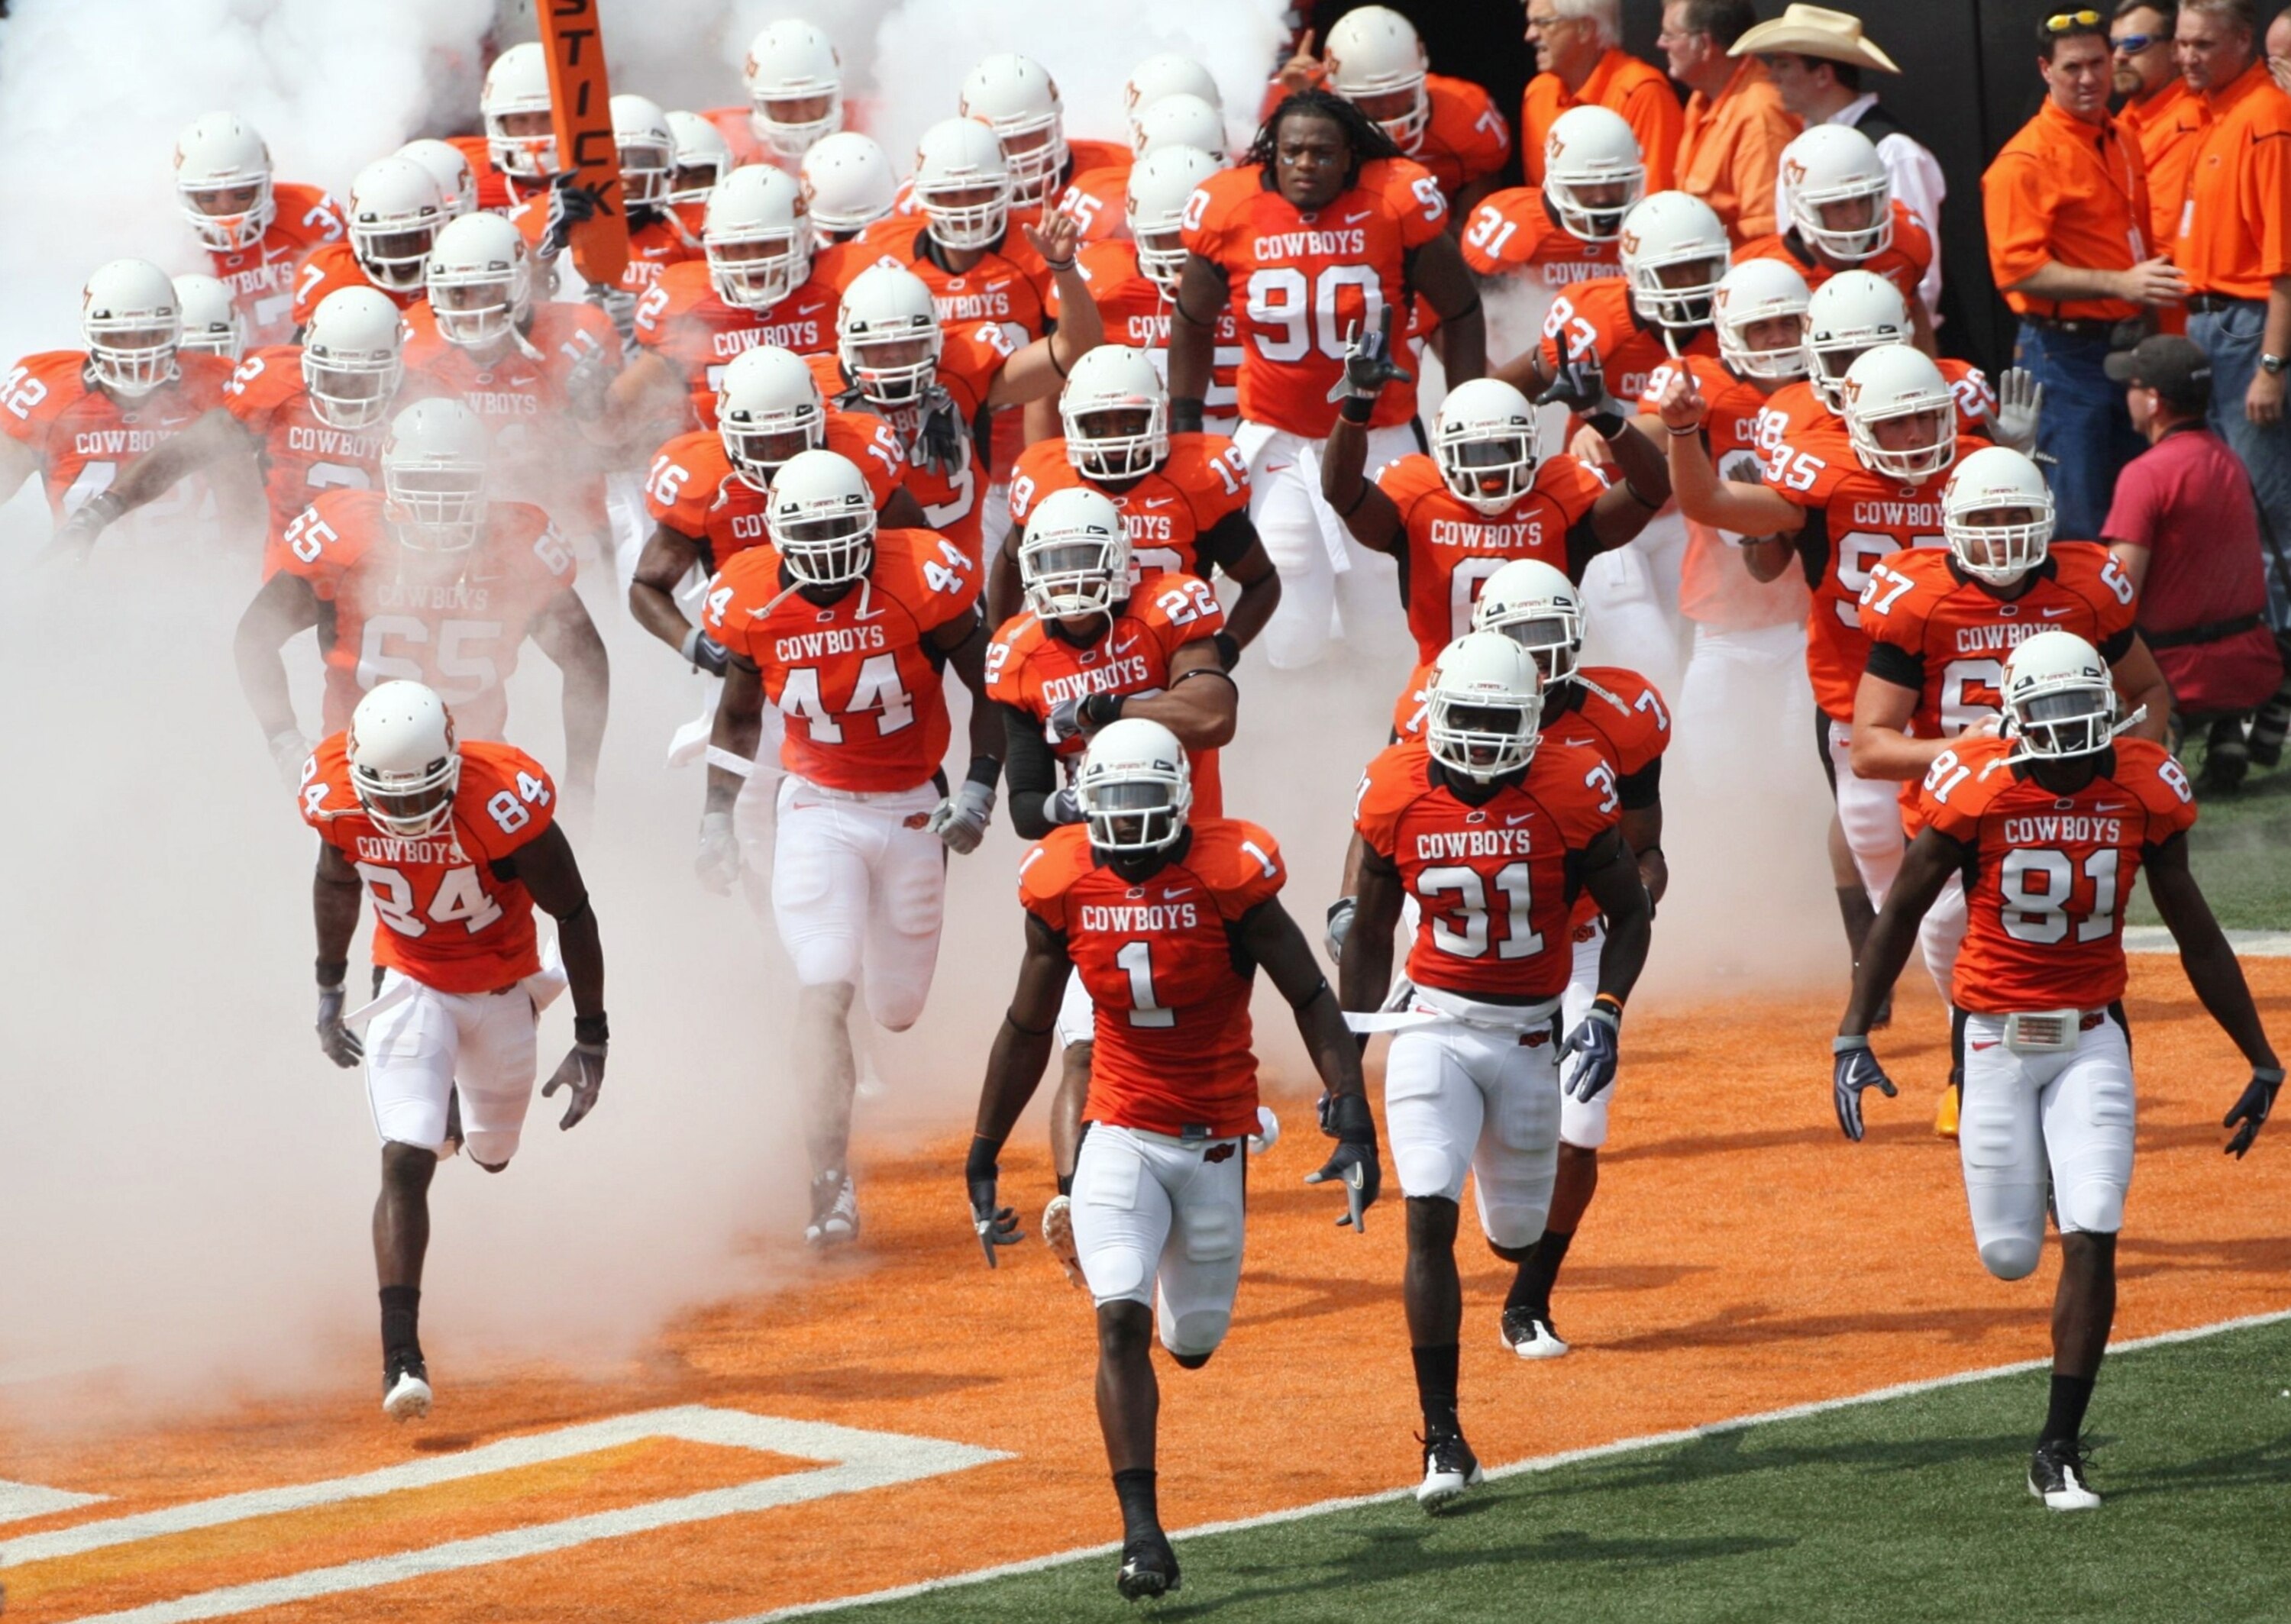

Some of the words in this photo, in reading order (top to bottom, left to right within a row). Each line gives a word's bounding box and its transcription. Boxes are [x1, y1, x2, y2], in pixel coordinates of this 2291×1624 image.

[1254, 229, 1365, 261] COWBOYS
[1467, 205, 1517, 260] 31
[1246, 265, 1386, 362] 90
[1543, 296, 1598, 360] 83
[713, 321, 818, 357] COWBOYS
[0, 366, 48, 420] 42
[289, 426, 384, 460] COWBOY
[868, 425, 904, 477] 16
[1766, 444, 1826, 490] 95
[645, 456, 689, 505] 16
[283, 506, 338, 563] 65
[1430, 518, 1542, 548] COWBOYS
[1853, 501, 1944, 527] COWBOY
[923, 539, 974, 595] 44
[1859, 563, 1915, 615] 67
[376, 585, 489, 610] COWBOYS
[1156, 580, 1220, 627] 22
[776, 625, 884, 662] COWBOYS
[777, 652, 915, 744] 44
[1041, 654, 1149, 707] COWBOYS
[1406, 689, 1428, 734] 7
[1635, 689, 1668, 732] 7
[1923, 749, 1970, 804] 81
[486, 770, 551, 835] 84
[355, 836, 466, 864] COWBOYS
[1417, 829, 1531, 860] COWBOYS
[2005, 816, 2120, 844] COWBOYS
[1242, 841, 1276, 878] 1
[354, 860, 504, 938] 84
[1081, 902, 1197, 931] COWBOYS
[1417, 862, 1544, 960] 31
[2001, 848, 2120, 944] 81
[1116, 941, 1175, 1028] 1
